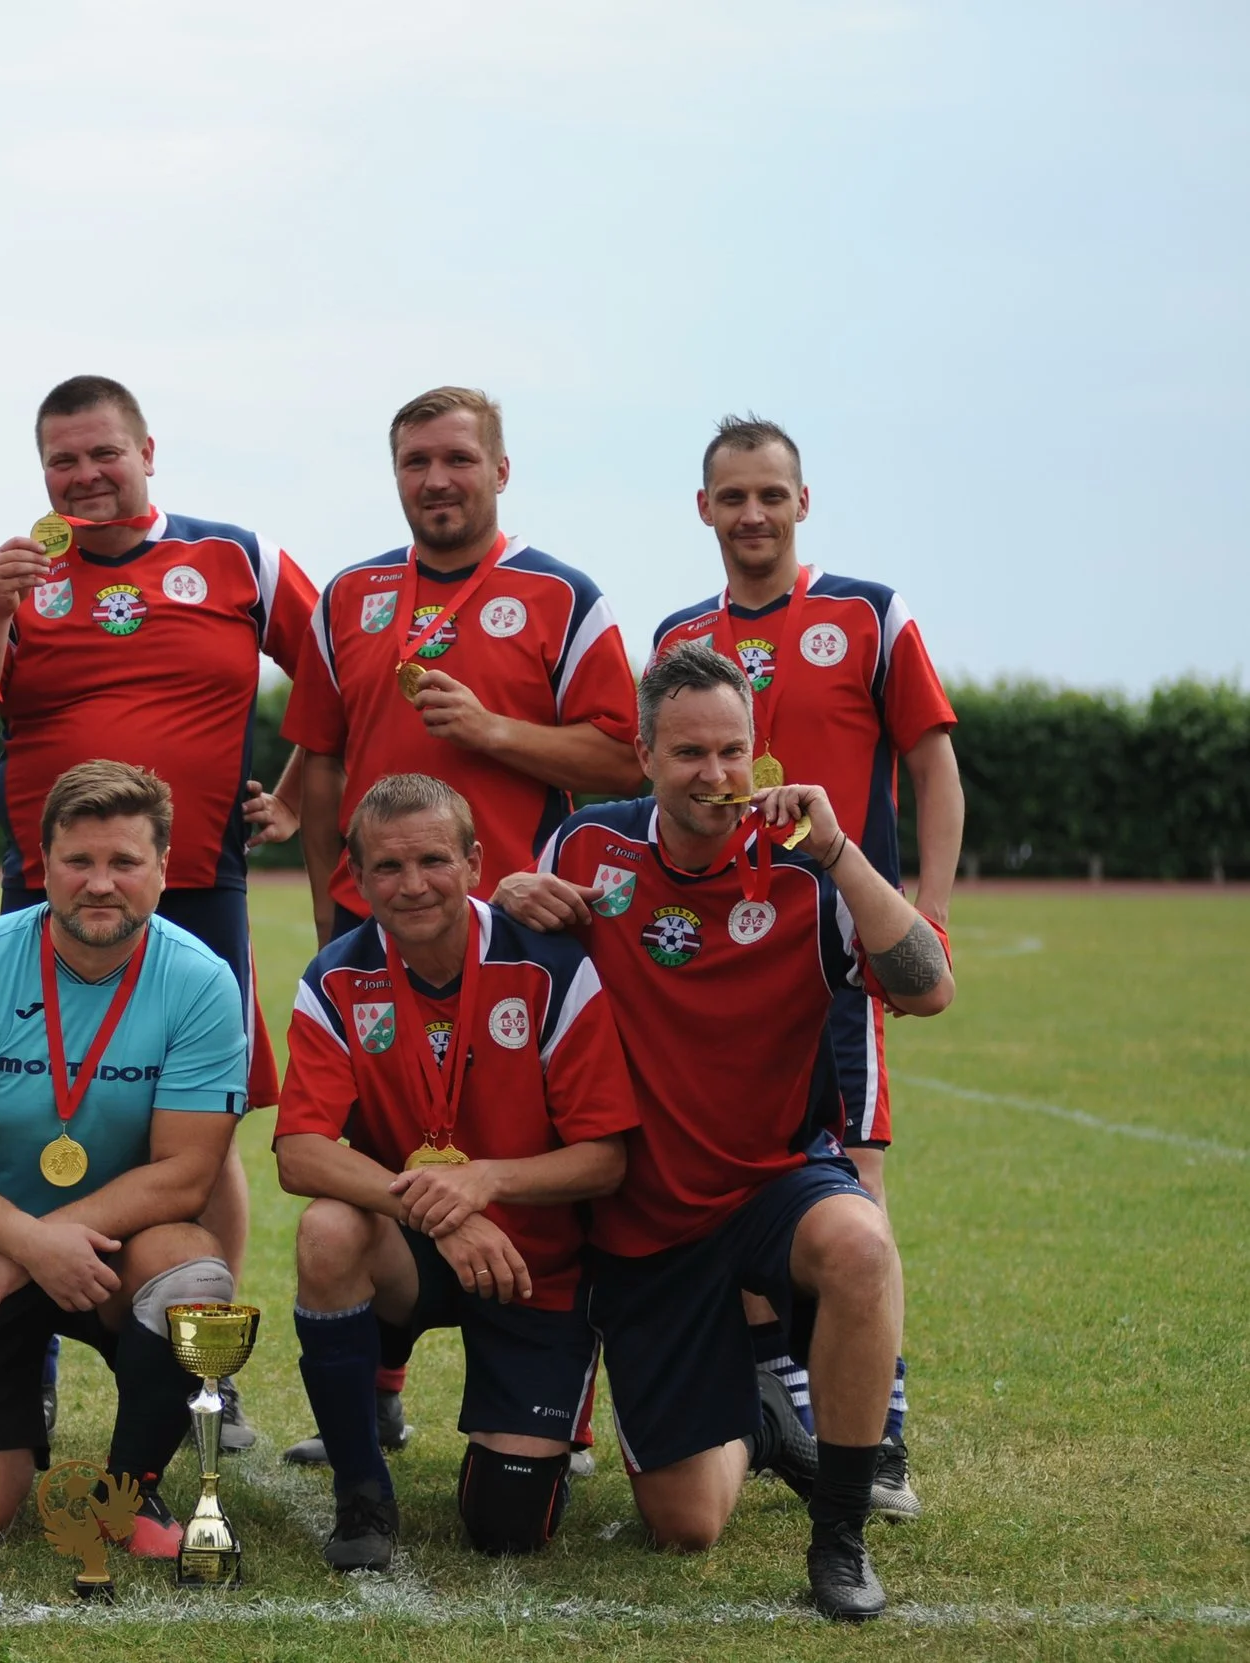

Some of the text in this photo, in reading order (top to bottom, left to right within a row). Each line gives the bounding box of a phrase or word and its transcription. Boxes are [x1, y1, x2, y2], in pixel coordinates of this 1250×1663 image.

[377, 572, 403, 583] Joma
[173, 582, 197, 591] LSVS
[110, 594, 128, 602] VK
[492, 611, 515, 623] LSVS
[694, 615, 719, 631] Joma
[737, 640, 773, 652] utbola
[812, 641, 836, 649] LSVS
[742, 650, 759, 658] VK
[613, 847, 642, 863] Joma
[656, 908, 699, 926] Futbola
[741, 917, 763, 926] LSVS
[666, 917, 686, 930] VK
[363, 980, 392, 991] Joma
[502, 1018, 525, 1028] LSVS
[542, 1407, 570, 1419] Joma
